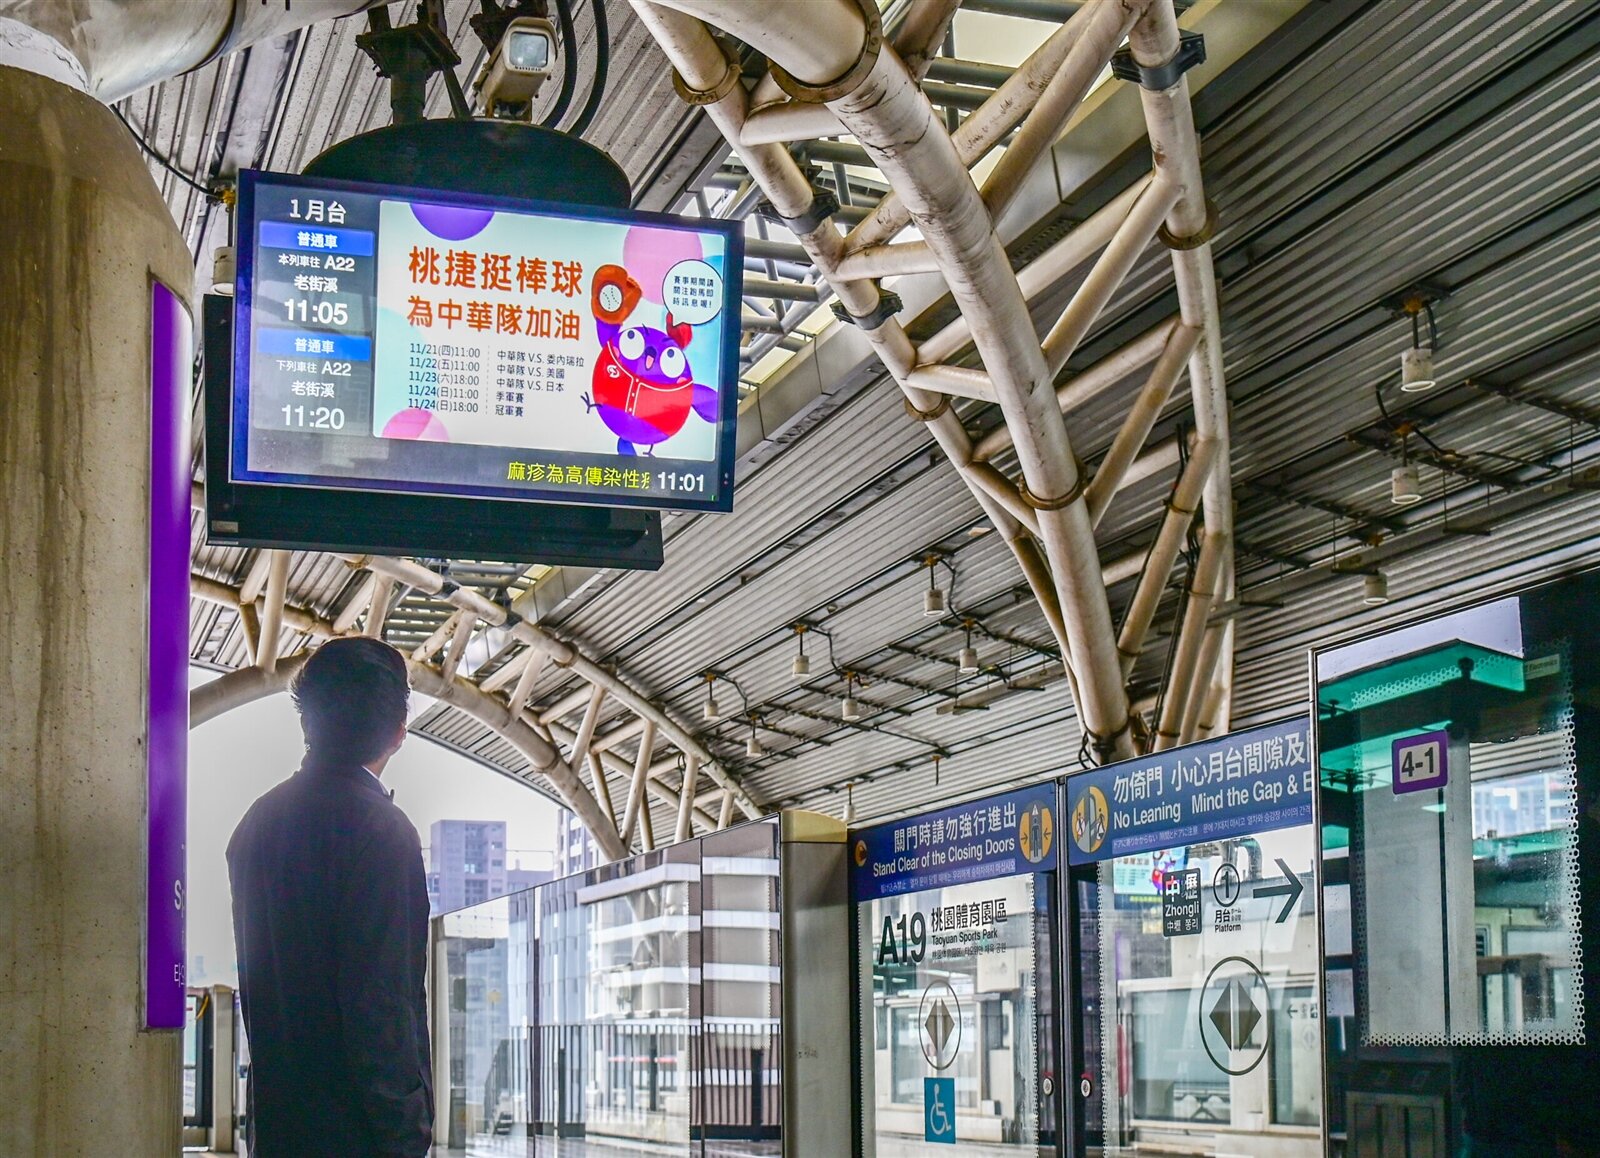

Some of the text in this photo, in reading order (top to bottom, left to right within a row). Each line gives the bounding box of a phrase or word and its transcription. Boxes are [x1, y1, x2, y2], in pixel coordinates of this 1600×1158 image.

[290, 199, 346, 224] 1月台
[297, 231, 338, 249] 普通車
[278, 253, 355, 272] 本列車往 A22
[408, 245, 582, 298] 桃捷挺棒球
[294, 274, 338, 293] 老街溪
[674, 276, 714, 287] 賽事期間請
[284, 299, 348, 325] 11:05
[407, 295, 580, 341] 為中華隊加油
[294, 337, 335, 354] 普通車
[410, 343, 585, 367] 11/21(四)11:00 中華隊 V.S. 委內瑞拉
[276, 359, 352, 377] 下列車往 A22
[409, 357, 565, 379] 11/22(五)11:00 中華隊 V.S. 美國
[291, 380, 335, 398] 老街溪
[409, 371, 564, 392] 11/23(六)18:00 中華隊 V.S. 日本
[408, 385, 524, 403] 11/24(日)11:00 季軍賽
[281, 404, 345, 430] 11:20
[408, 399, 524, 417] 11/24(日)18:00 冠軍賽
[657, 471, 704, 492] 11:01
[1402, 747, 1434, 777] 4-1
[1114, 765, 1163, 803] 勿倚門
[1113, 811, 1130, 830] No
[1133, 802, 1181, 823] Leaning
[1192, 788, 1224, 815] Mind
[1227, 783, 1249, 806] the
[1253, 777, 1283, 803] Gap
[1287, 773, 1299, 794] &
[894, 802, 1017, 853] 關門時請勿強行進出
[873, 837, 1015, 877] Stand Clear of the Closing Doors
[931, 897, 1008, 933] 桃園體育園區
[1165, 901, 1200, 917] Zhongli
[1214, 909, 1231, 923] 月台
[878, 911, 926, 965] A19
[932, 928, 998, 948] Taoyuan Sports Park
[1214, 924, 1242, 933] Platform
